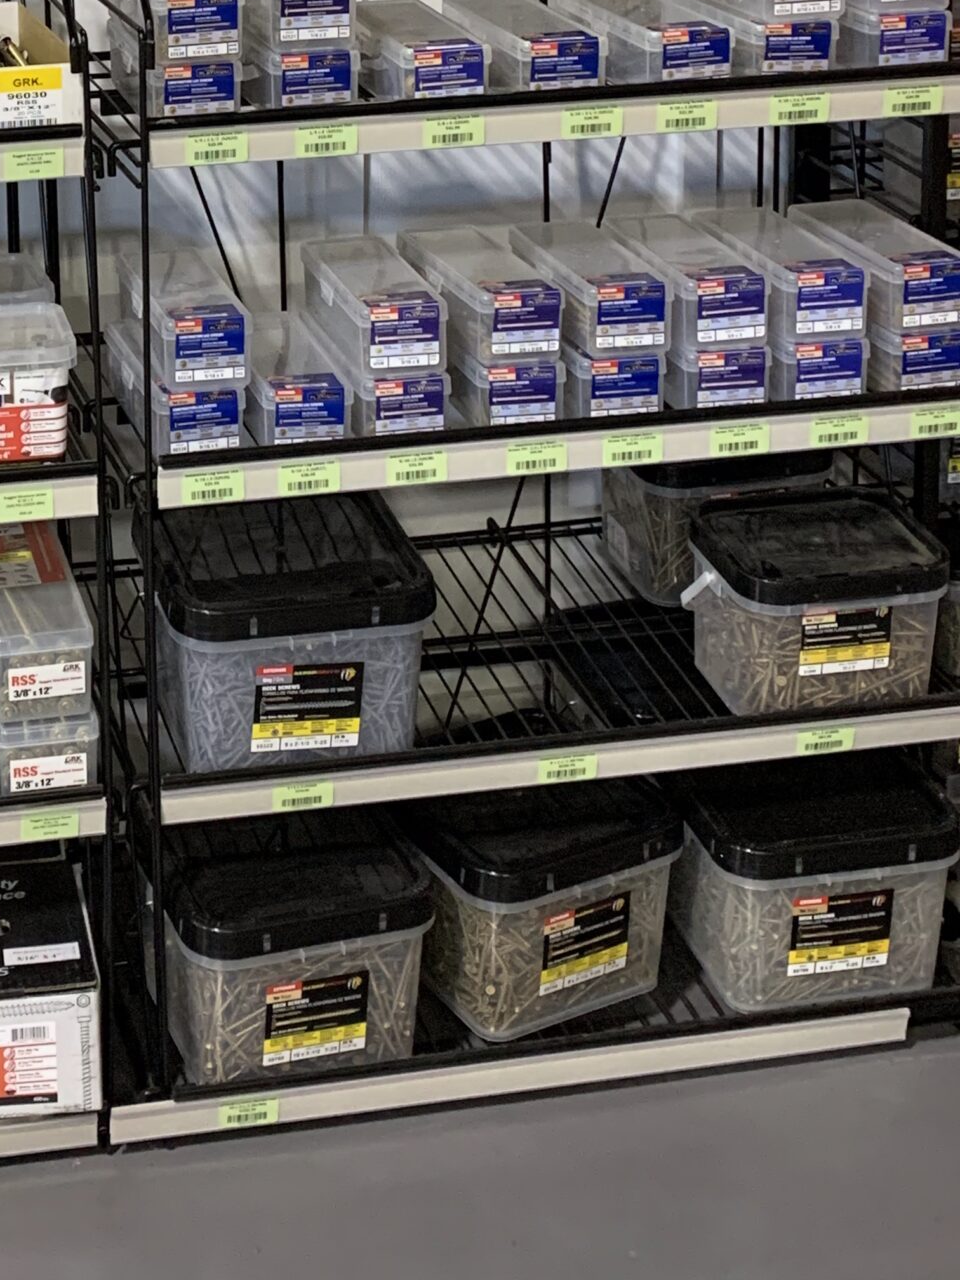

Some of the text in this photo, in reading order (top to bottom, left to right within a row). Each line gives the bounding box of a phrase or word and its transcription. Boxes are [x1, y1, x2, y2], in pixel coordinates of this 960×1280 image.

[13, 77, 39, 88] GRK
[7, 91, 48, 100] 96030
[11, 674, 37, 687] RSS
